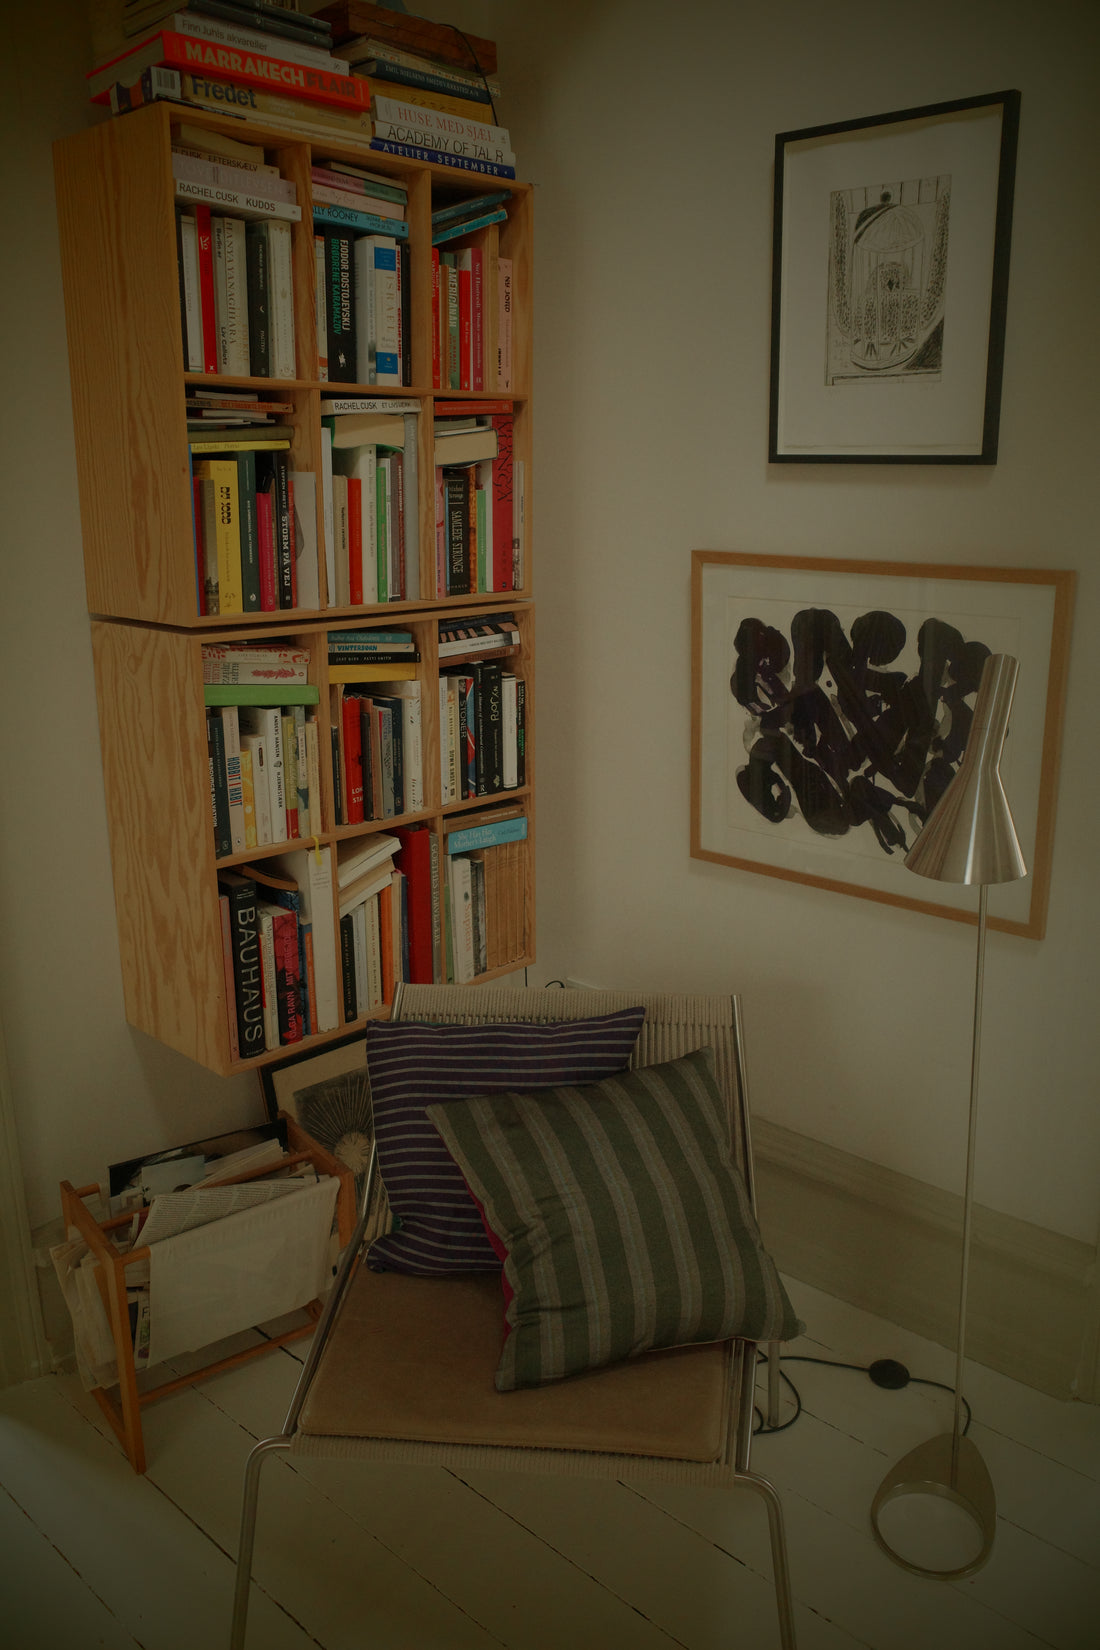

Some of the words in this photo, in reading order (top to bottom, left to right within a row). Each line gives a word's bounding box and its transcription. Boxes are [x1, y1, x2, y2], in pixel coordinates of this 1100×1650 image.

[182, 20, 201, 34] Finn
[185, 41, 305, 87] MARRAKECH
[306, 71, 356, 99] FLAIR
[191, 74, 257, 108] Fredet
[398, 106, 434, 128] HUSE
[436, 118, 465, 136] MED
[467, 126, 496, 144] SJÆL
[383, 143, 430, 161] ATELIER
[437, 155, 499, 176] SEPTEMBER
[388, 125, 450, 150] ACADEMY
[453, 140, 470, 155] OF
[473, 144, 492, 161] TAL
[496, 150, 504, 163] R
[208, 152, 258, 172] EFTERSKÆLV
[179, 182, 215, 199] RACHEL
[216, 191, 239, 205] CUSK
[246, 197, 276, 212] KUDOS
[327, 208, 359, 222] ROONEY
[226, 222, 235, 263] HANYA
[340, 239, 349, 272] FJODOR
[331, 238, 340, 284] BRØDRENE
[227, 266, 237, 345] YANAGIHARA
[332, 284, 342, 335] KARAMAZOV
[341, 273, 350, 331] DOSTOJEVSKIJ
[385, 276, 395, 332] ISRAEL
[448, 267, 457, 328] AMERICANAH
[334, 402, 360, 410] RACHEL
[361, 402, 377, 410] CUSK
[493, 421, 508, 502] MANGA
[452, 510, 463, 541] SAMLEDE
[283, 552, 290, 566] PÅ
[452, 543, 464, 574] STRUNGE
[492, 686, 500, 697] NY
[490, 697, 500, 721] JORD
[227, 757, 241, 781] HOBBIT
[229, 788, 242, 808] HABIT
[463, 903, 472, 952] Sapiens
[238, 906, 262, 1043] BAUHAUS
[285, 971, 293, 986] MIT
[287, 991, 295, 1015] RAVN
[288, 1015, 297, 1039] OLGA
